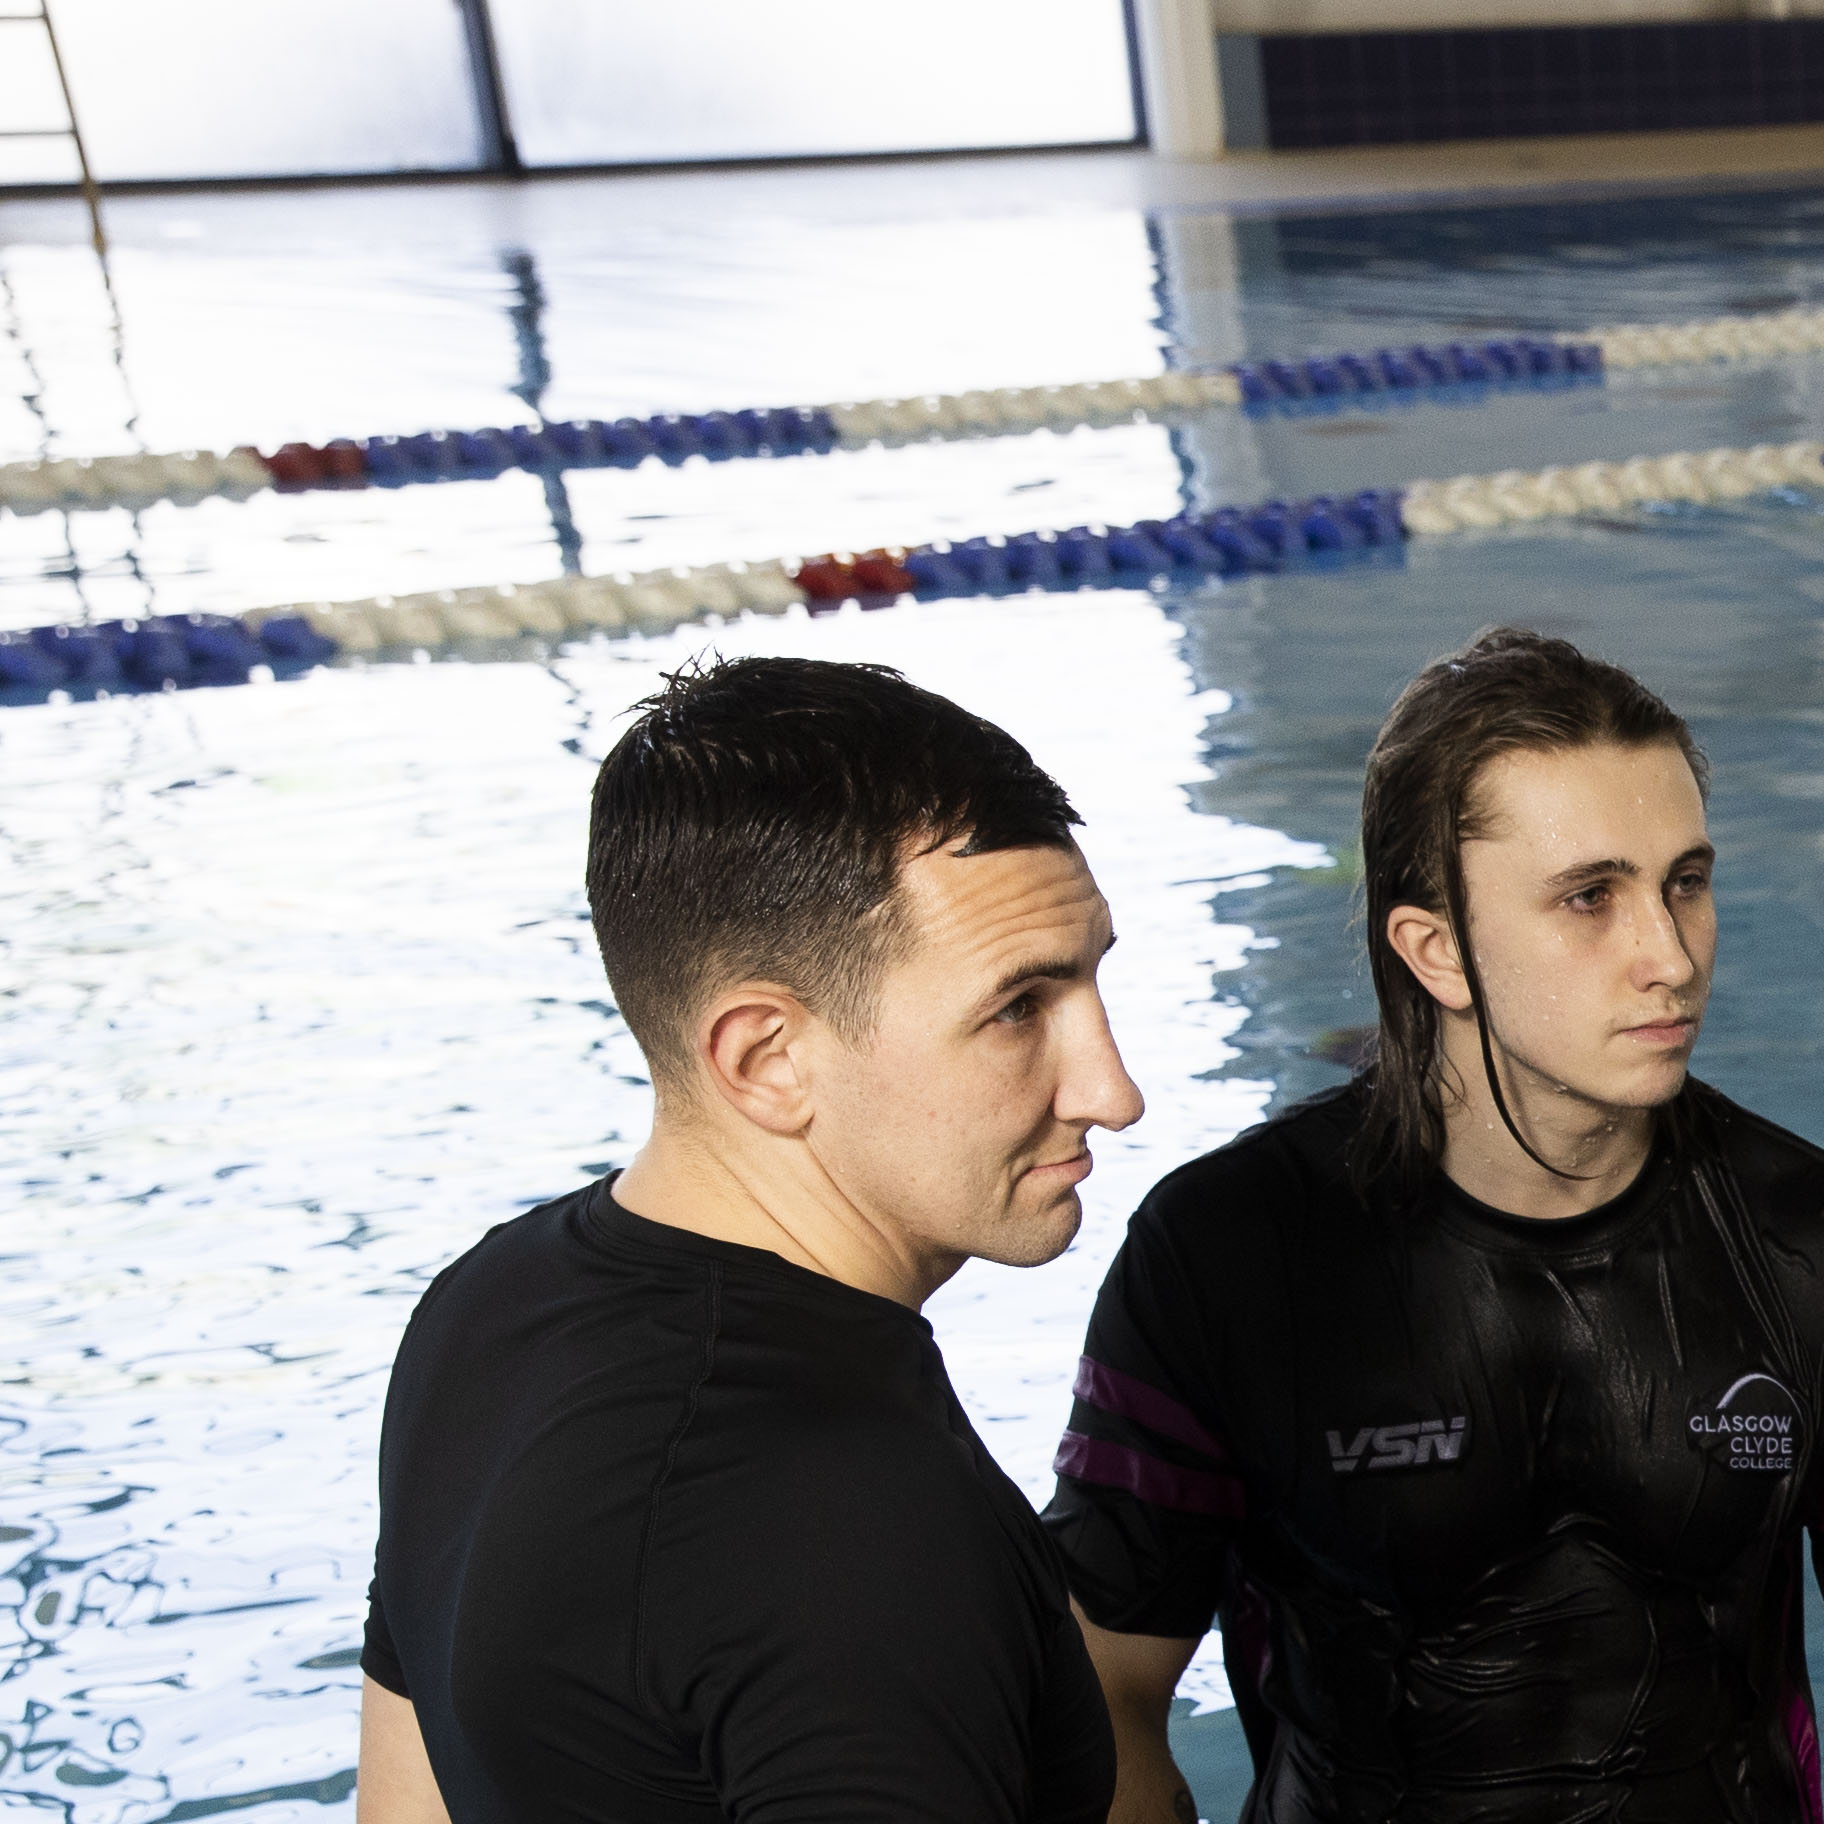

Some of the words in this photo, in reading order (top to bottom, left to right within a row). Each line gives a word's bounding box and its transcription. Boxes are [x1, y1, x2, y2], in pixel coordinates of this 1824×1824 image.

[1689, 1415, 1792, 1433] GLASGOW
[1325, 1416, 1465, 1472] VSN
[1730, 1436, 1792, 1454] CLYDE
[1729, 1457, 1792, 1469] COLLEGE
